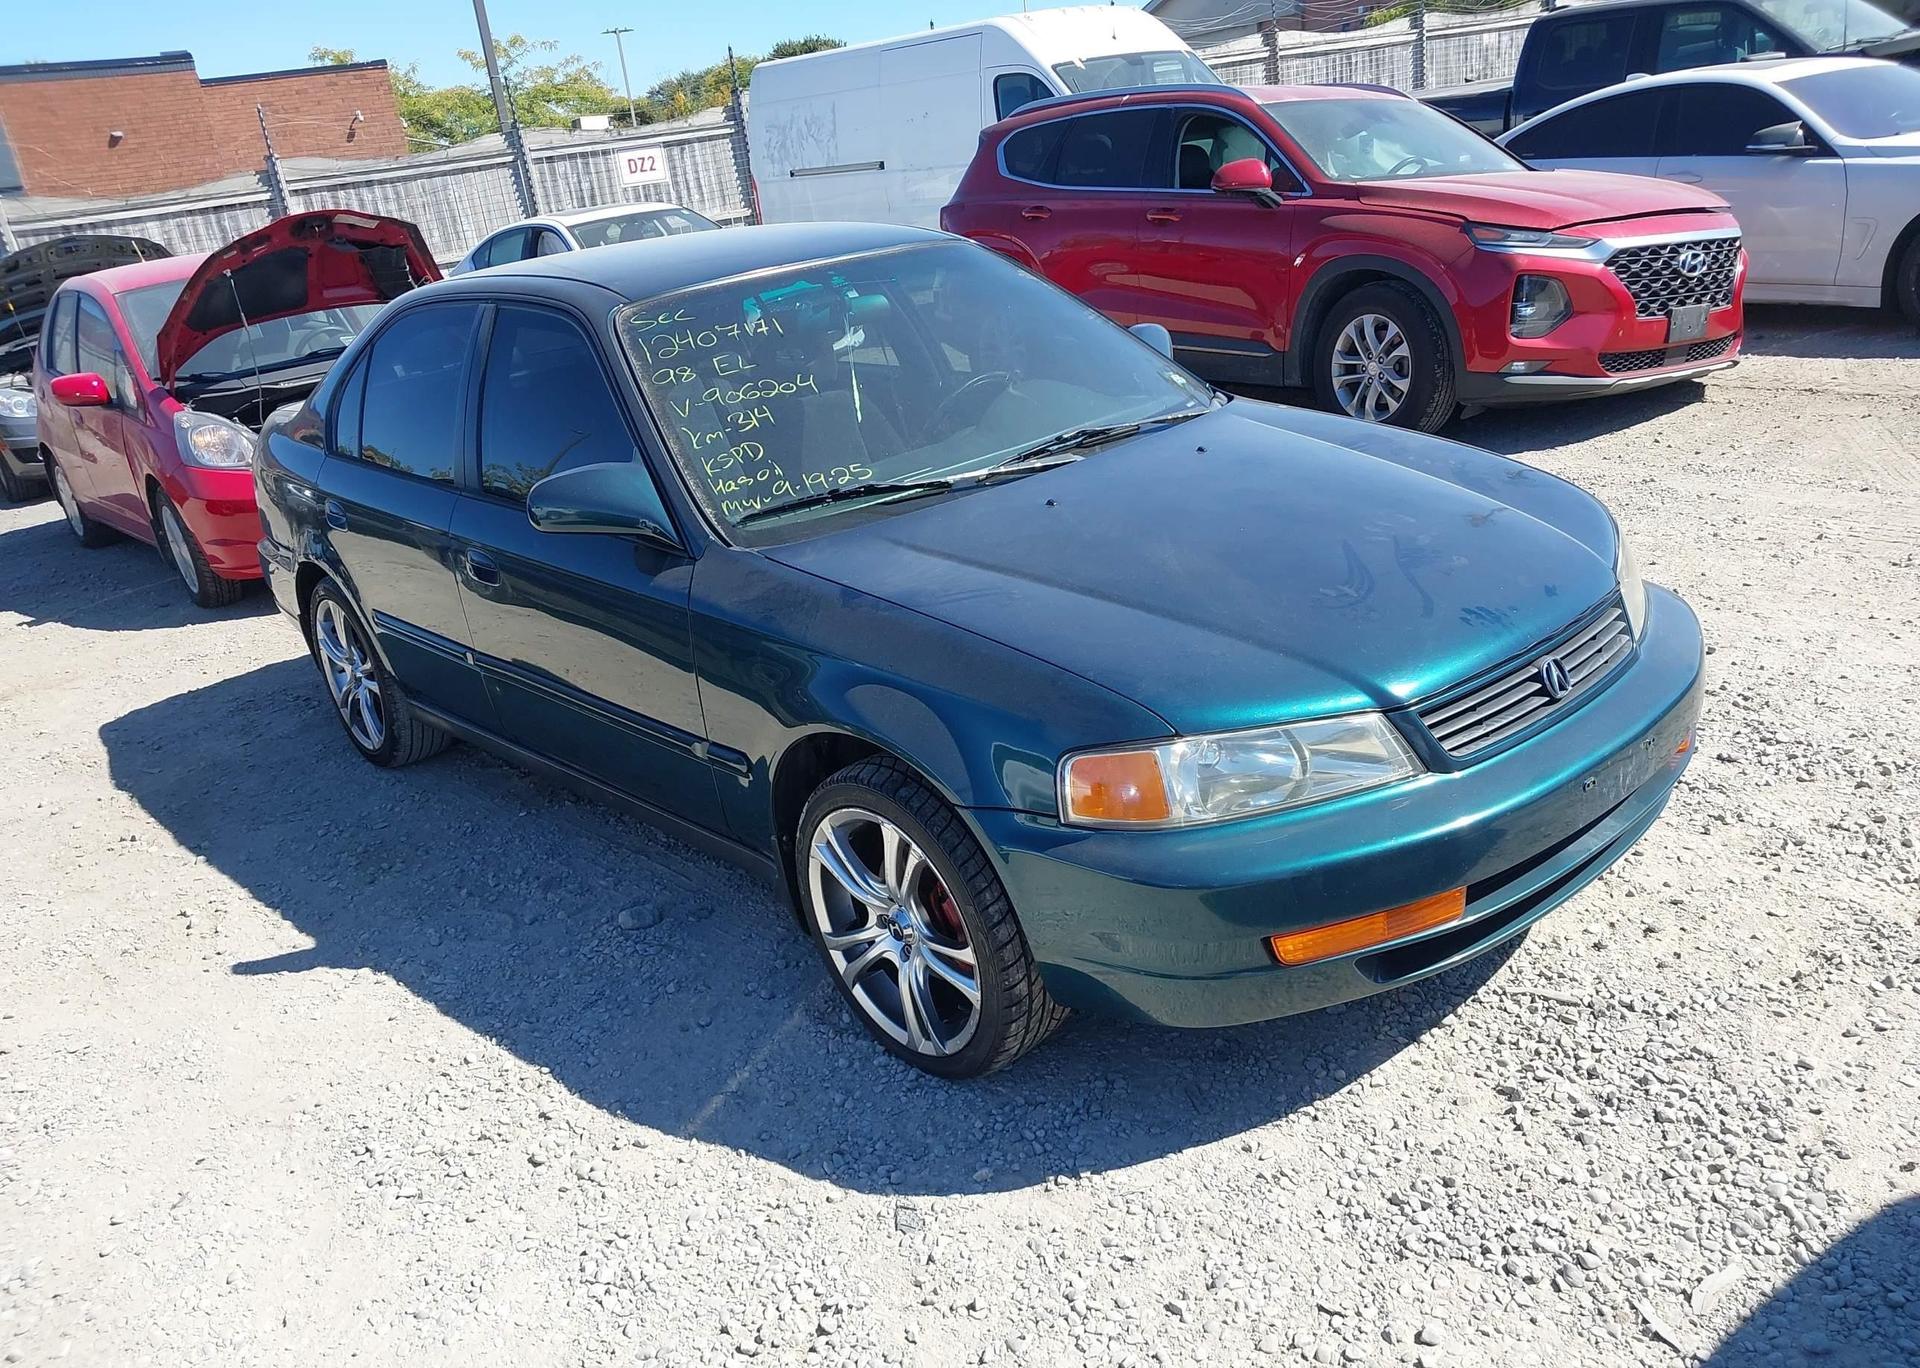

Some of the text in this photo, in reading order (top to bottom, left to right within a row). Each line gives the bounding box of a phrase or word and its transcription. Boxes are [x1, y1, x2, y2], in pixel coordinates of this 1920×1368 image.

[627, 156, 657, 174] DZ2
[638, 318, 784, 365] 12407171
[652, 354, 758, 385] 98 EL
